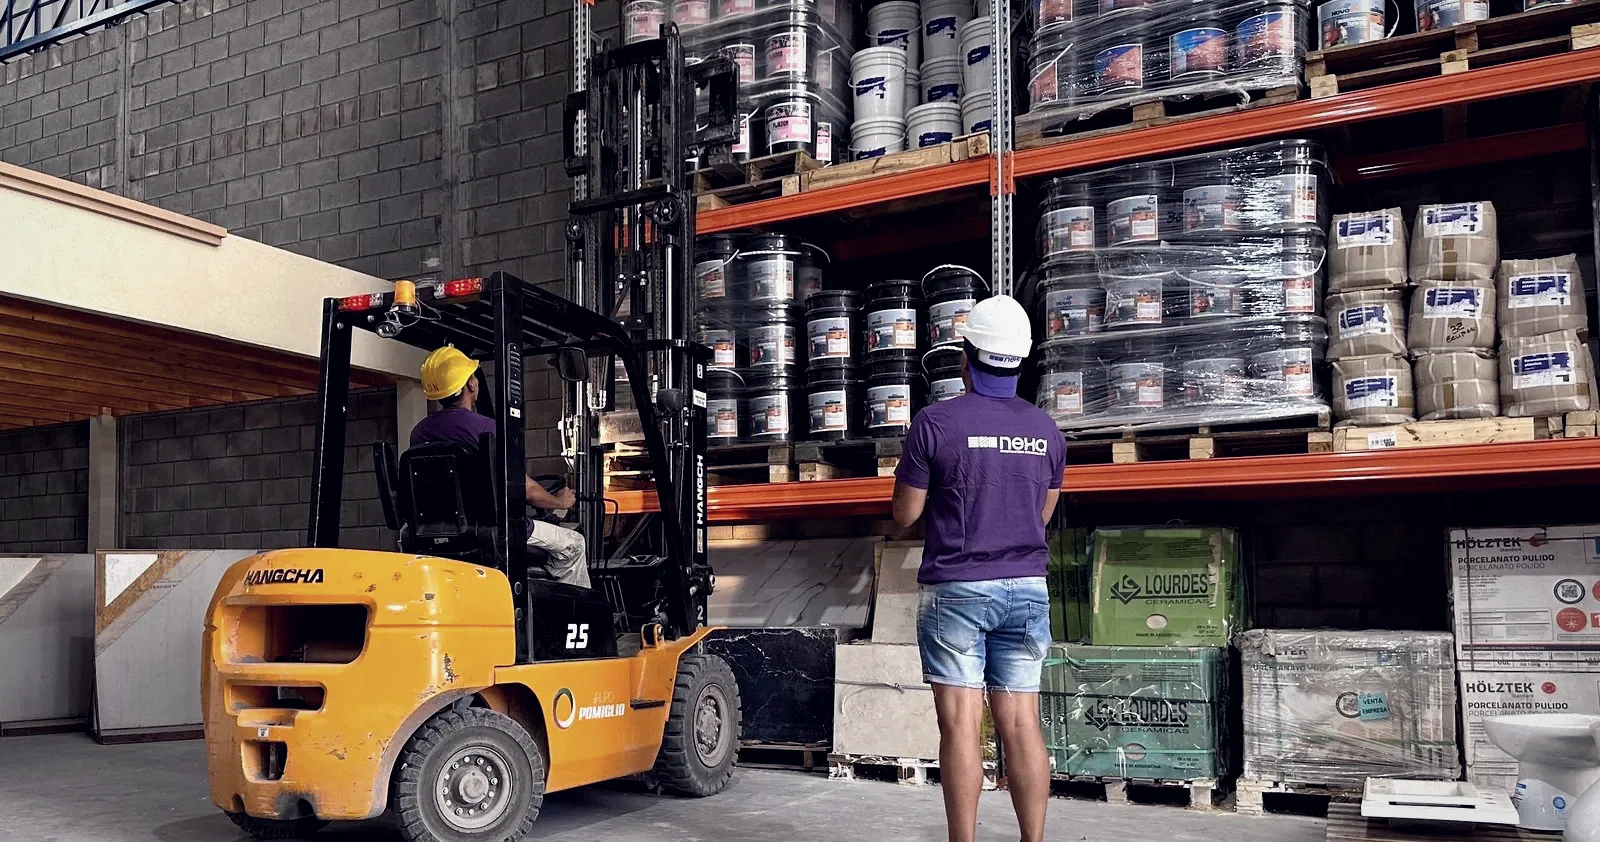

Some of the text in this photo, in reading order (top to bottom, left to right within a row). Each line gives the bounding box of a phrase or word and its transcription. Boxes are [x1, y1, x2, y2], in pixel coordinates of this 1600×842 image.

[1331, 8, 1350, 16] NOVO
[1450, 322, 1464, 335] 32
[1456, 537, 1521, 549] HÖLZTEK
[1458, 554, 1555, 564] PORCELANATO PULIDO
[243, 568, 324, 585] HANGCHA
[1145, 573, 1208, 594] LOURDES
[565, 623, 589, 649] 25
[1465, 680, 1534, 693] HÖLZTEK
[578, 703, 625, 720] POMIGLIO
[1121, 699, 1188, 723] LOURDES
[1468, 702, 1532, 710] PORCELANATO
[1121, 727, 1190, 735] CERAMICAS
